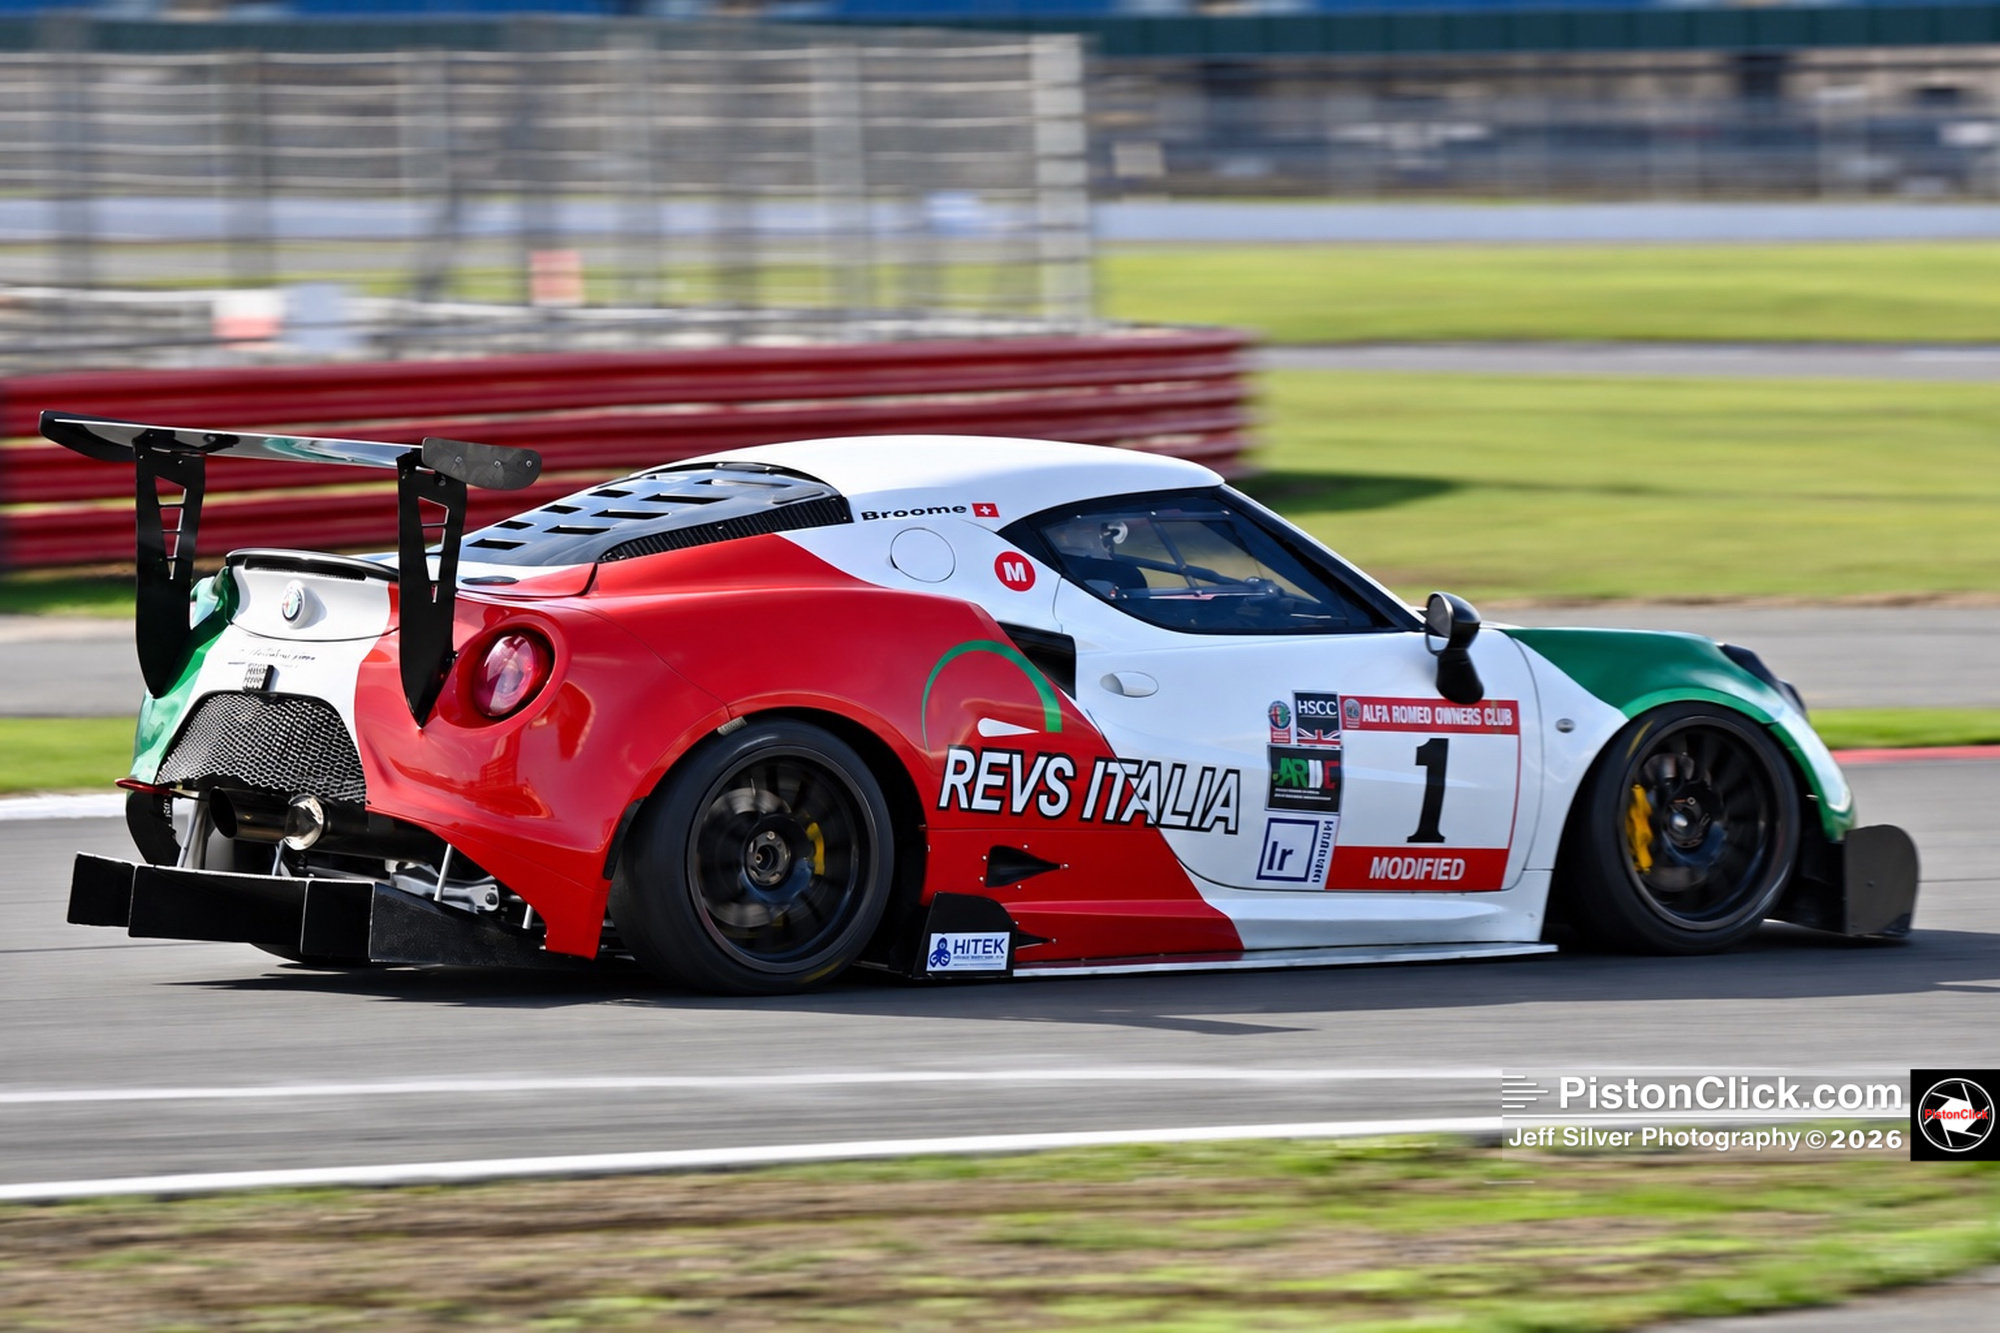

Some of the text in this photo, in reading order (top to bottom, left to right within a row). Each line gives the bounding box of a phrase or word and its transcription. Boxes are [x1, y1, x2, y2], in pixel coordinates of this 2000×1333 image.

[860, 504, 967, 521] Broome
[1002, 561, 1027, 582] M
[1297, 700, 1337, 716] HSCC
[1362, 704, 1390, 723] ALFA
[1392, 705, 1432, 724] ROMEO
[1435, 707, 1482, 726] OWNERS
[1484, 707, 1513, 726] CLUB
[937, 744, 1241, 835] REVS ITALIA
[1406, 738, 1449, 843] 1
[1369, 856, 1466, 881] MODIFIED
[953, 938, 1006, 955] HITEK
